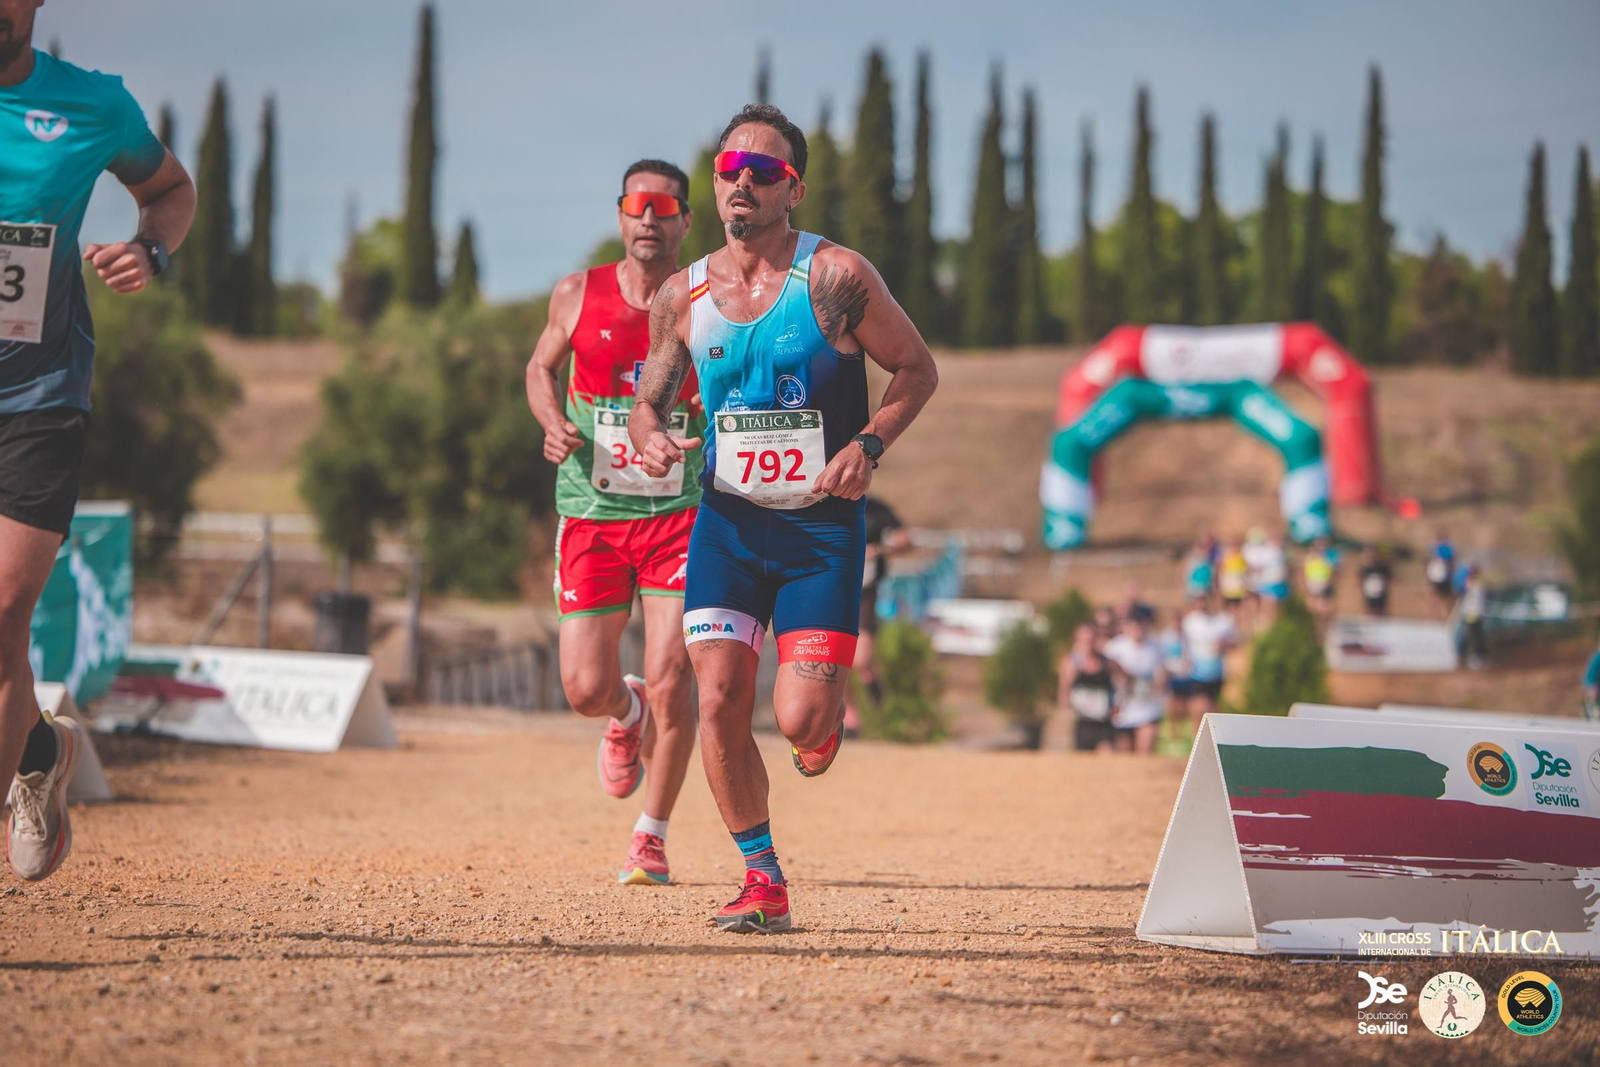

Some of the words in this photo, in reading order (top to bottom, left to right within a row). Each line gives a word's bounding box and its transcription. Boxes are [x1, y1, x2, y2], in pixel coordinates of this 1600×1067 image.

[0, 265, 25, 302] 3
[742, 414, 792, 429] ITÁLICA
[737, 448, 806, 484] 792
[1532, 781, 1578, 794] Diputación
[1535, 792, 1580, 808] Sevilla
